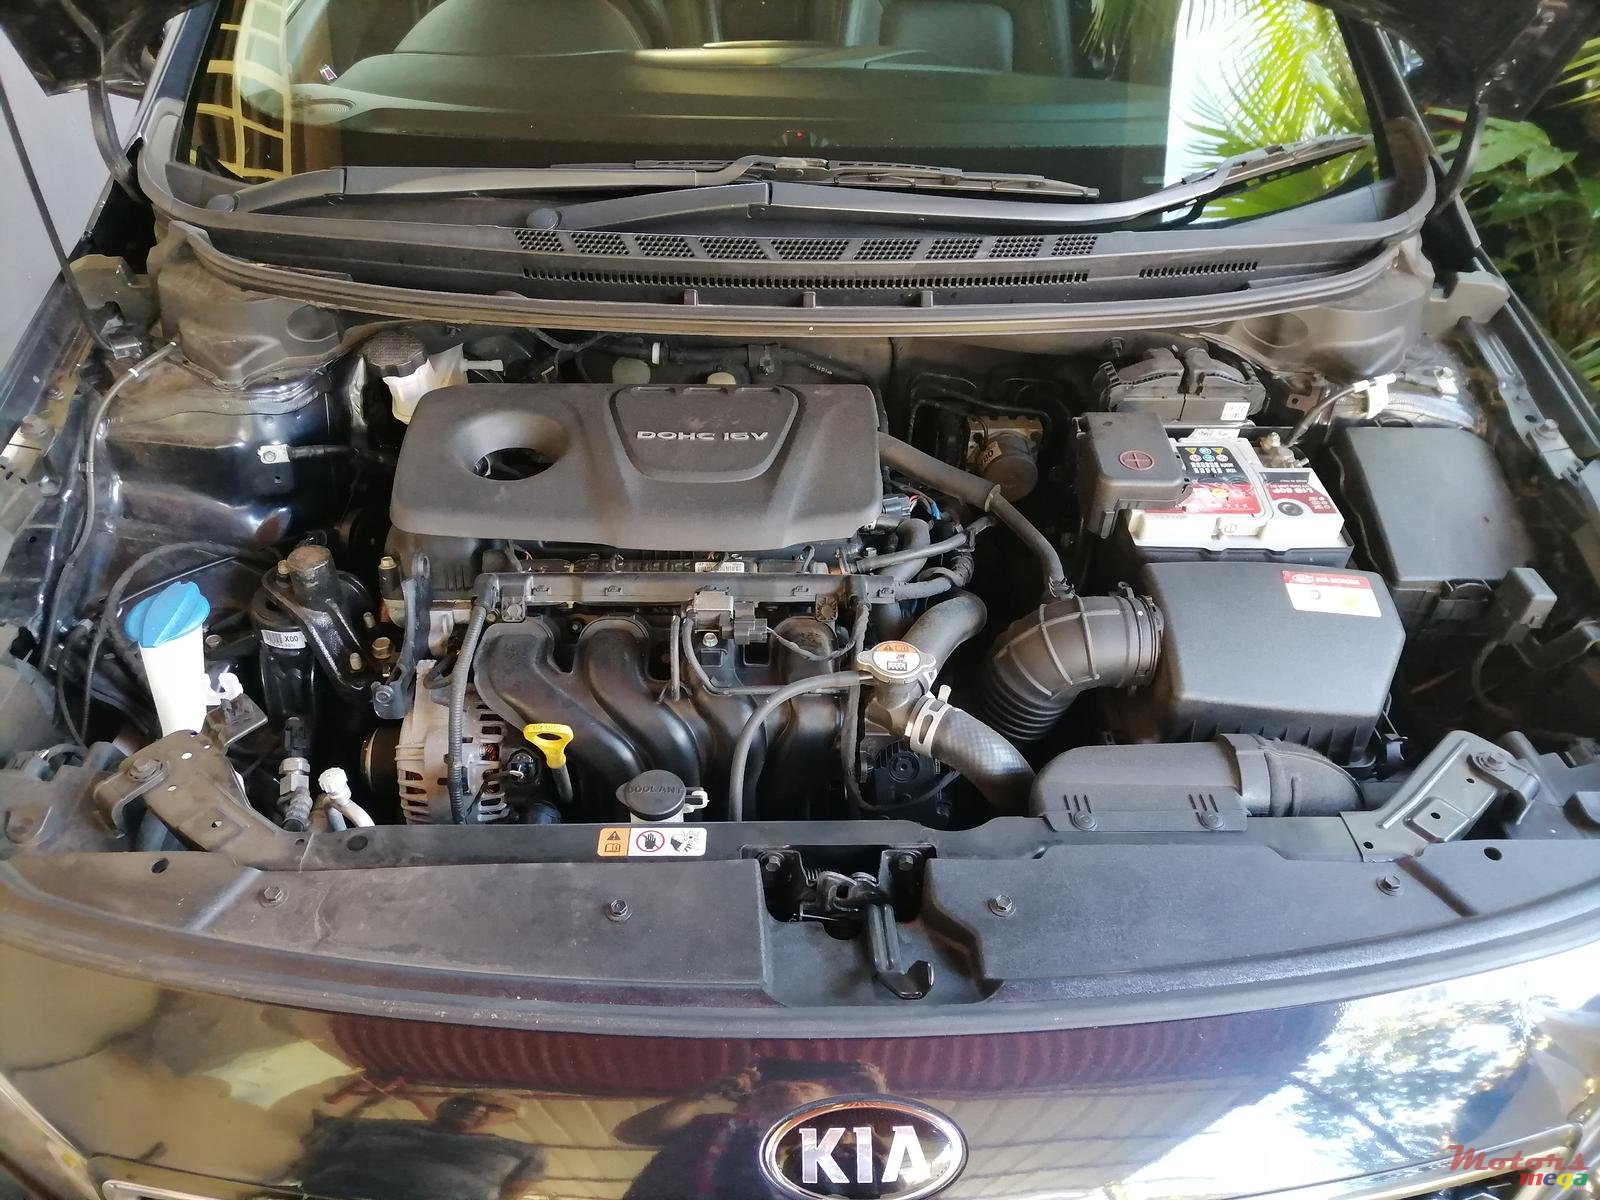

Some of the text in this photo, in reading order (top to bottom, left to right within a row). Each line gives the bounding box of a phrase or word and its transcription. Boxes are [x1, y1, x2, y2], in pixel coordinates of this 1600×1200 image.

[637, 431, 768, 441] DOHC 16V
[627, 785, 684, 794] COOLANT
[799, 1126, 932, 1184] KIA
